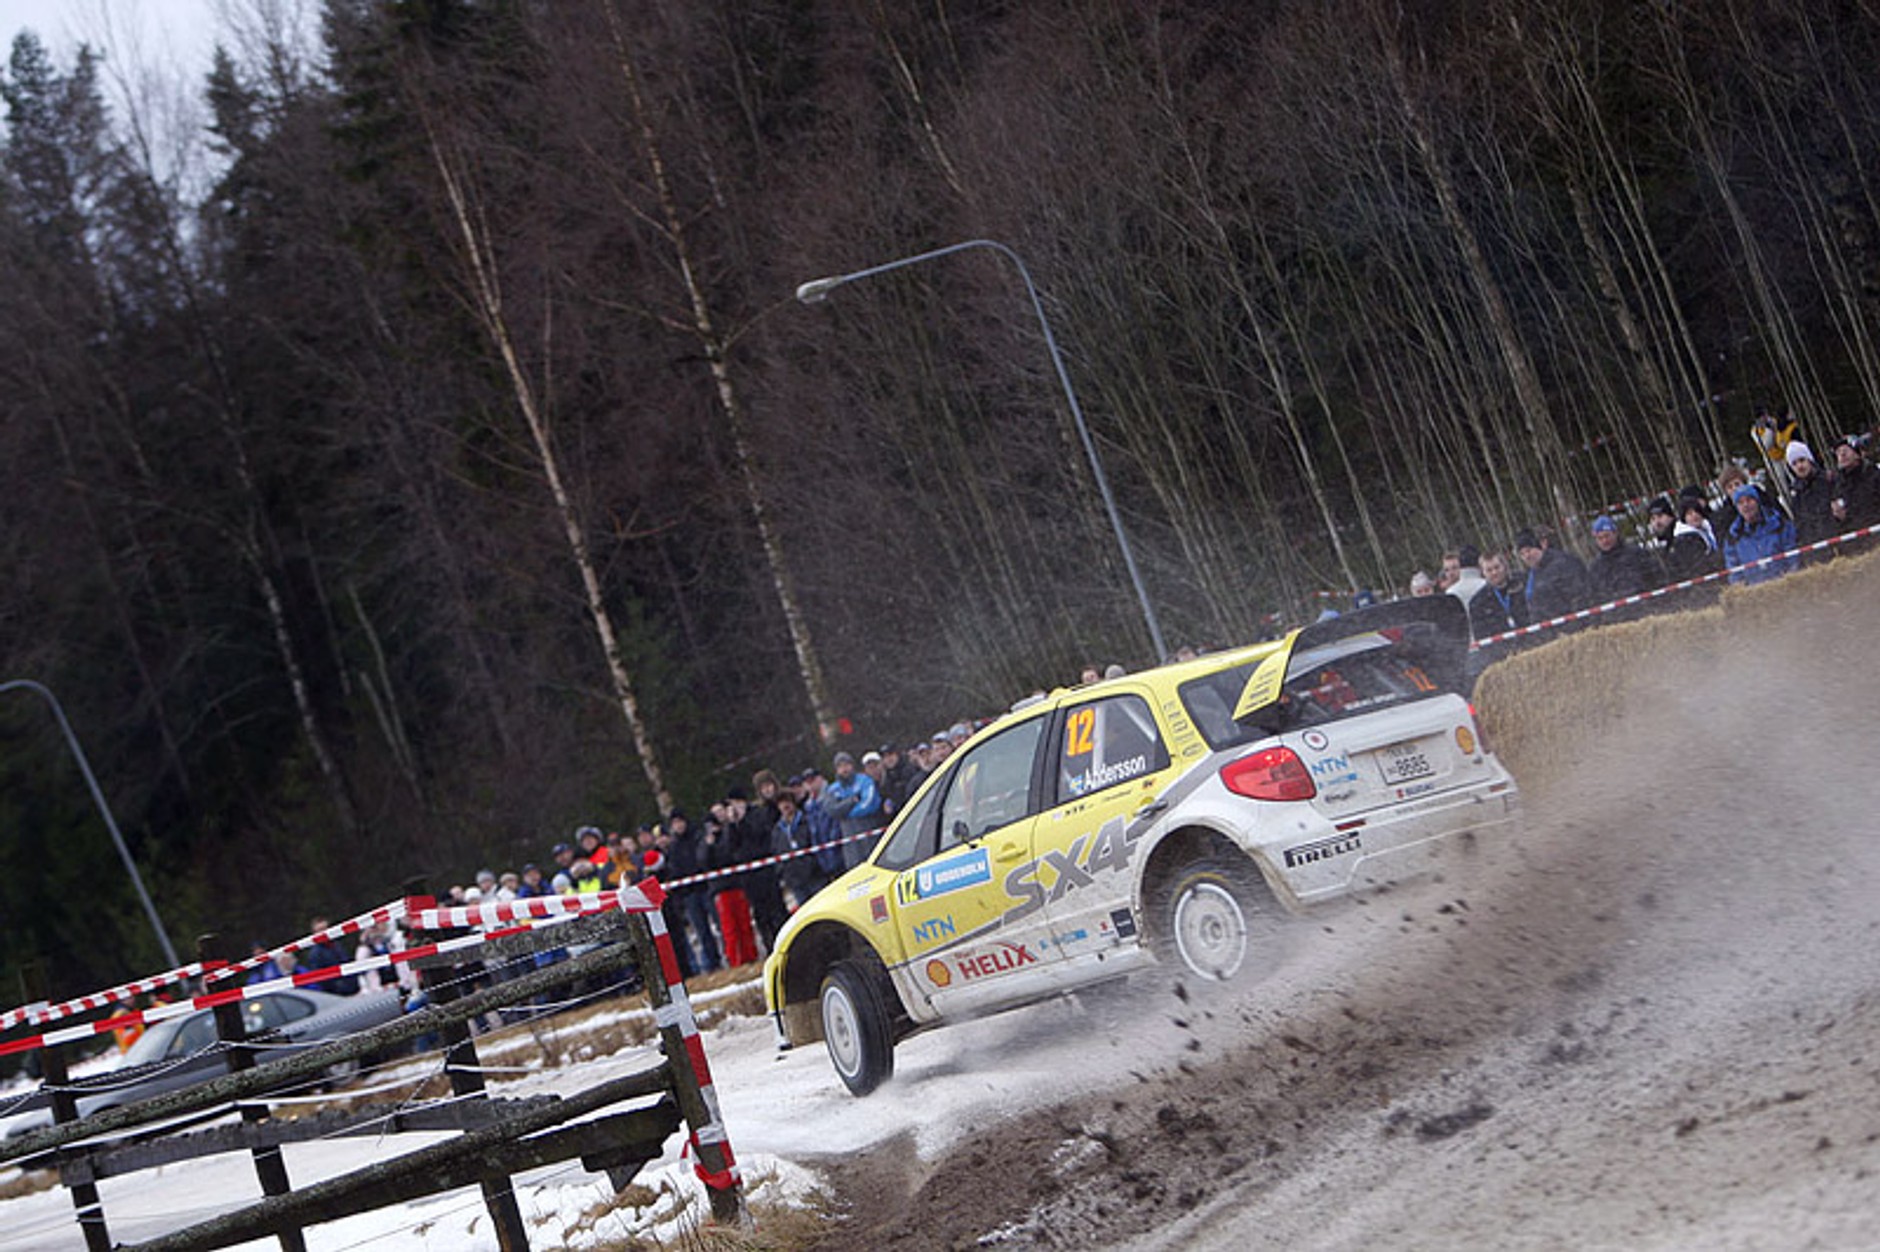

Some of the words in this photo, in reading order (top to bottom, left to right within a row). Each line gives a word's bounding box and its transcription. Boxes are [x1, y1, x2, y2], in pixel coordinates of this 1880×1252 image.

[1066, 708, 1095, 756] 12
[1084, 755, 1146, 792] Andersson
[1311, 752, 1349, 776] NTN
[1283, 831, 1361, 868] PIRELLI
[1003, 815, 1139, 926] SX4
[912, 914, 956, 943] NTN
[958, 944, 1036, 980] HELIX
